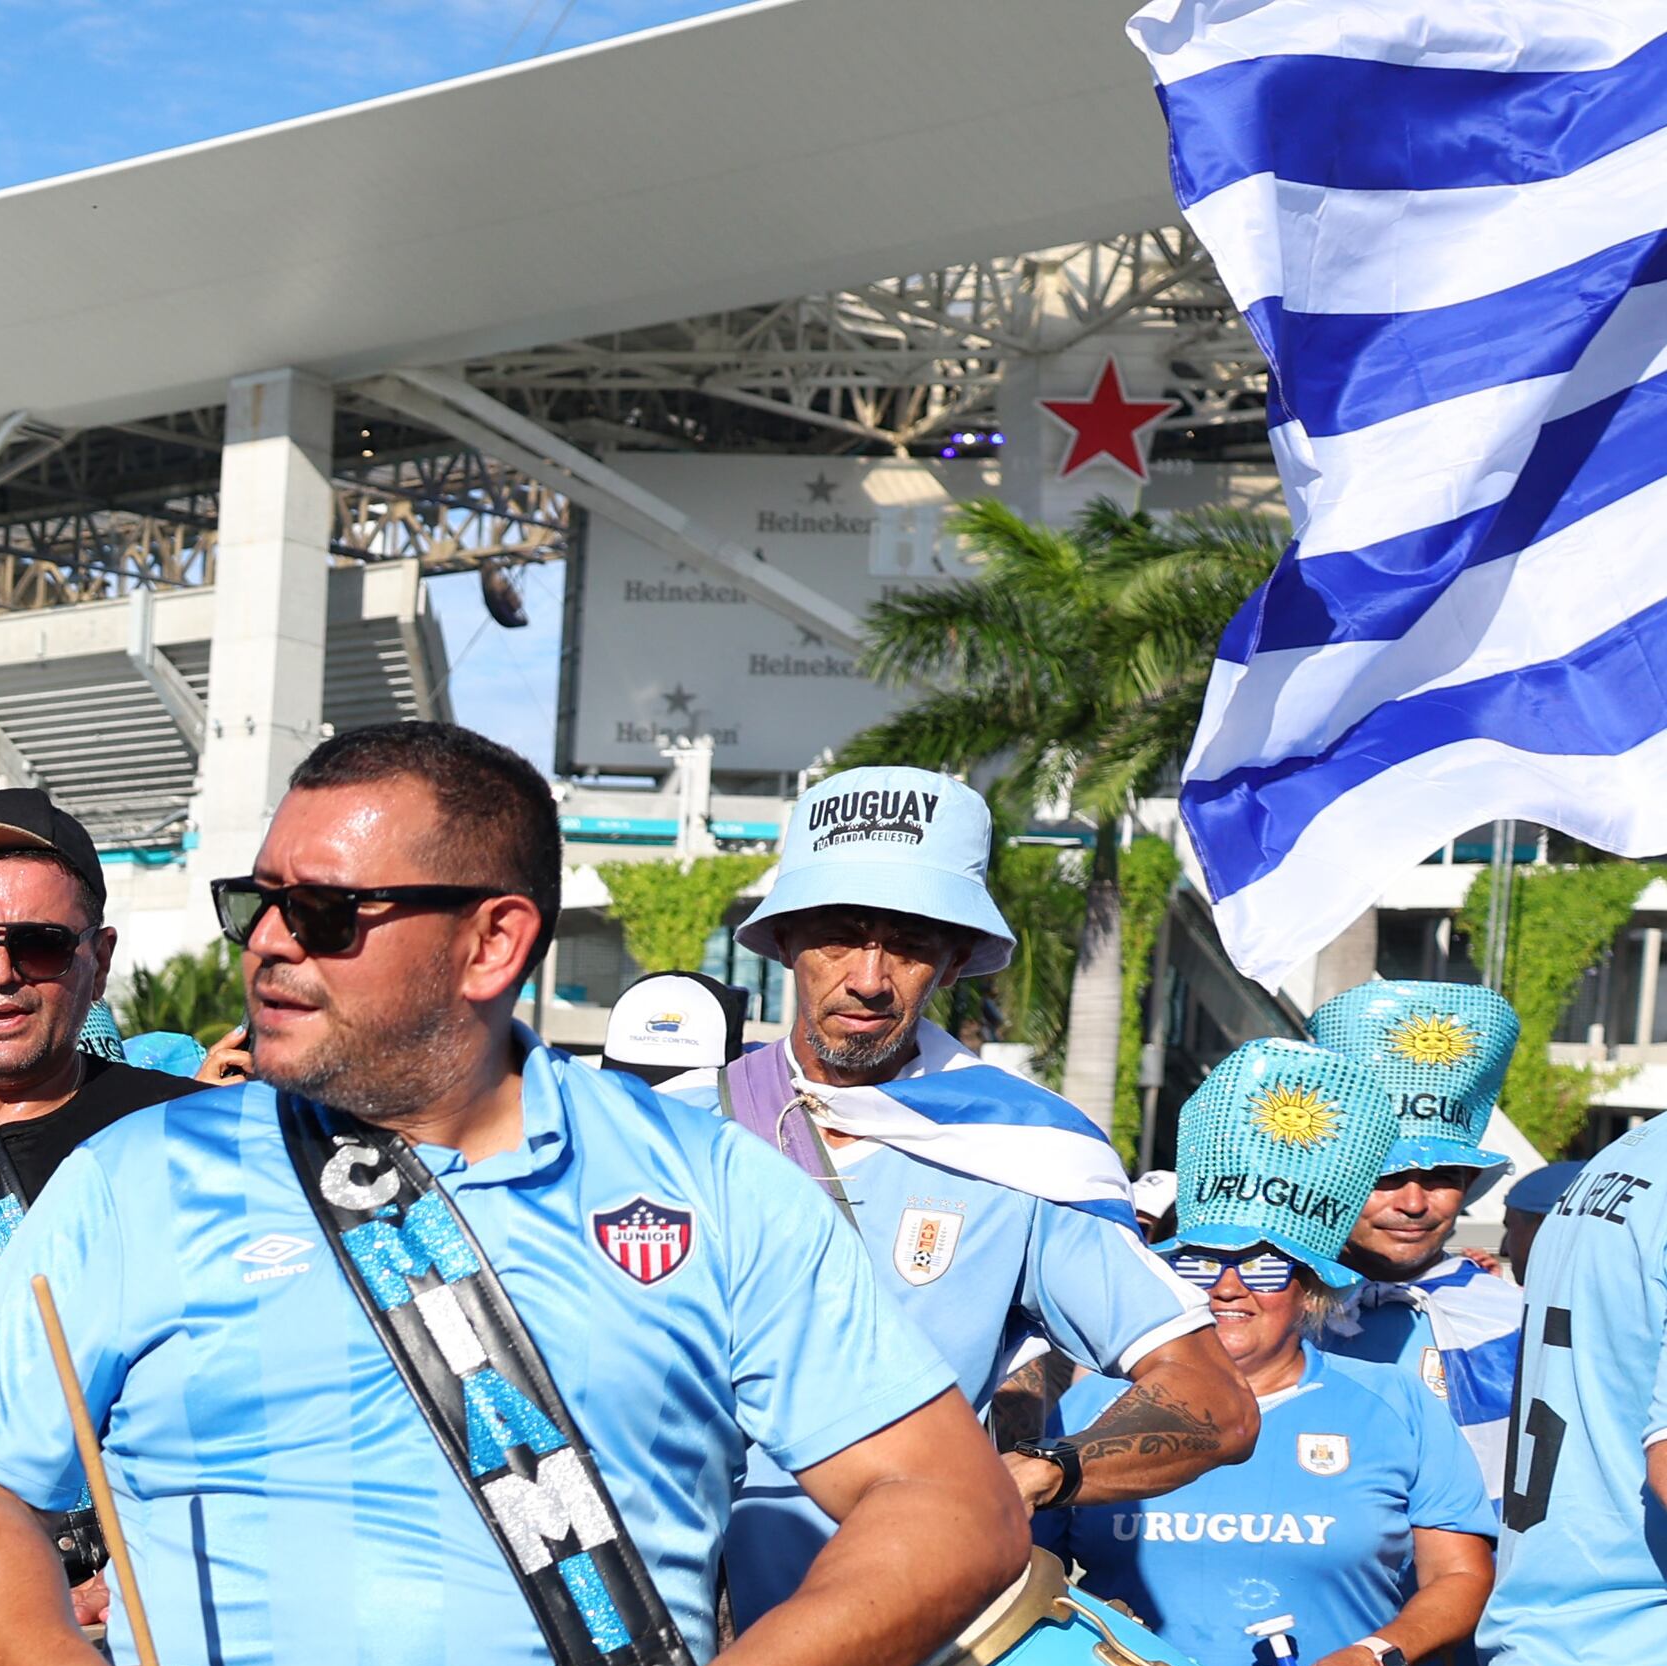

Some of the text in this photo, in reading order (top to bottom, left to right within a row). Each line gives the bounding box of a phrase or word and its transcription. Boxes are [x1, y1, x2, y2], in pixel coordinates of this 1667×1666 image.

[624, 580, 747, 604] Heineken
[616, 722, 739, 746] Heien
[809, 790, 939, 832] URUGUAY
[817, 831, 917, 851] LA BANDA CELESTE
[1197, 1173, 1351, 1230] URUGUAY
[612, 1231, 676, 1242] JUNIOR
[243, 1263, 309, 1285] umbro
[1112, 1511, 1336, 1544] URUGUAY
